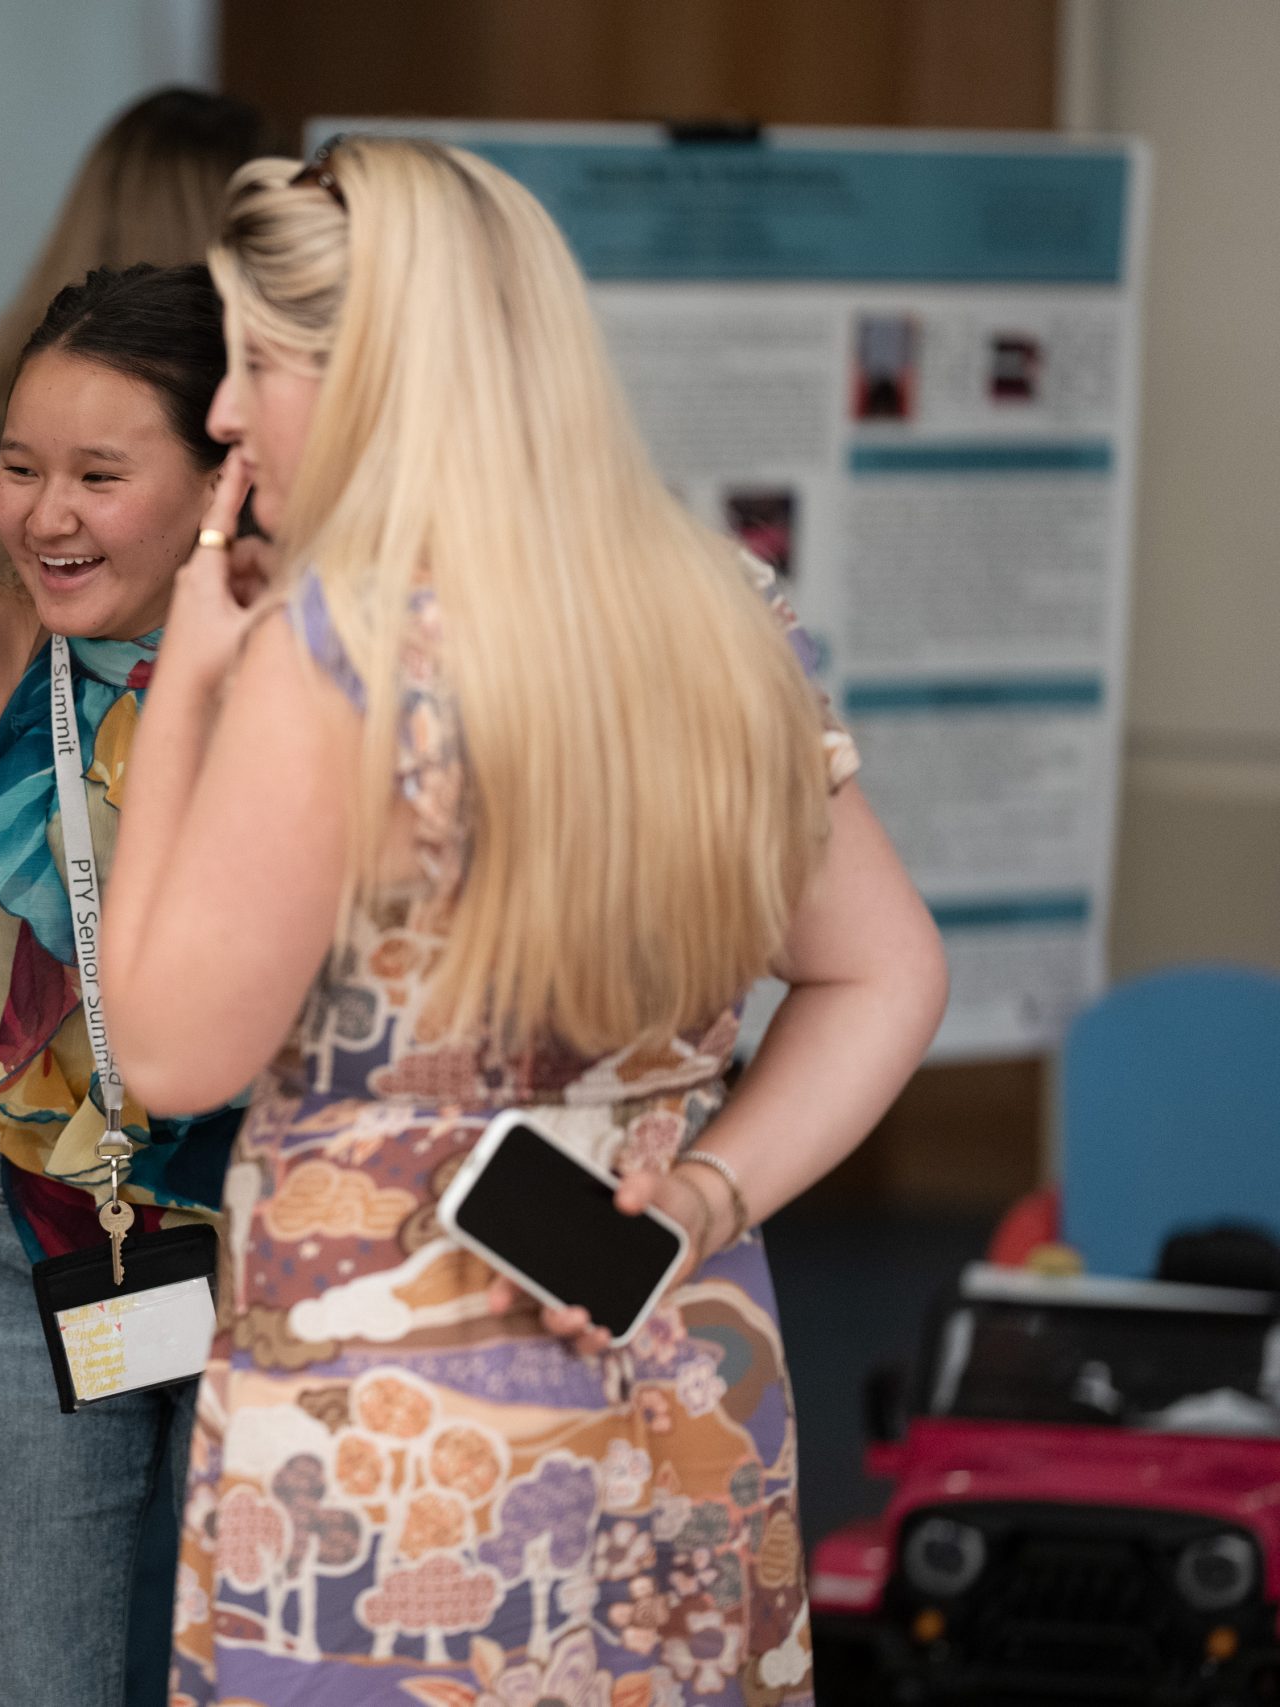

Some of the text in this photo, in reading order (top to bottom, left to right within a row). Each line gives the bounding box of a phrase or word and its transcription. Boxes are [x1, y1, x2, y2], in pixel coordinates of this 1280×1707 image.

[54, 663, 75, 756] Summit
[71, 859, 96, 903] PTY
[76, 911, 100, 988] Senior
